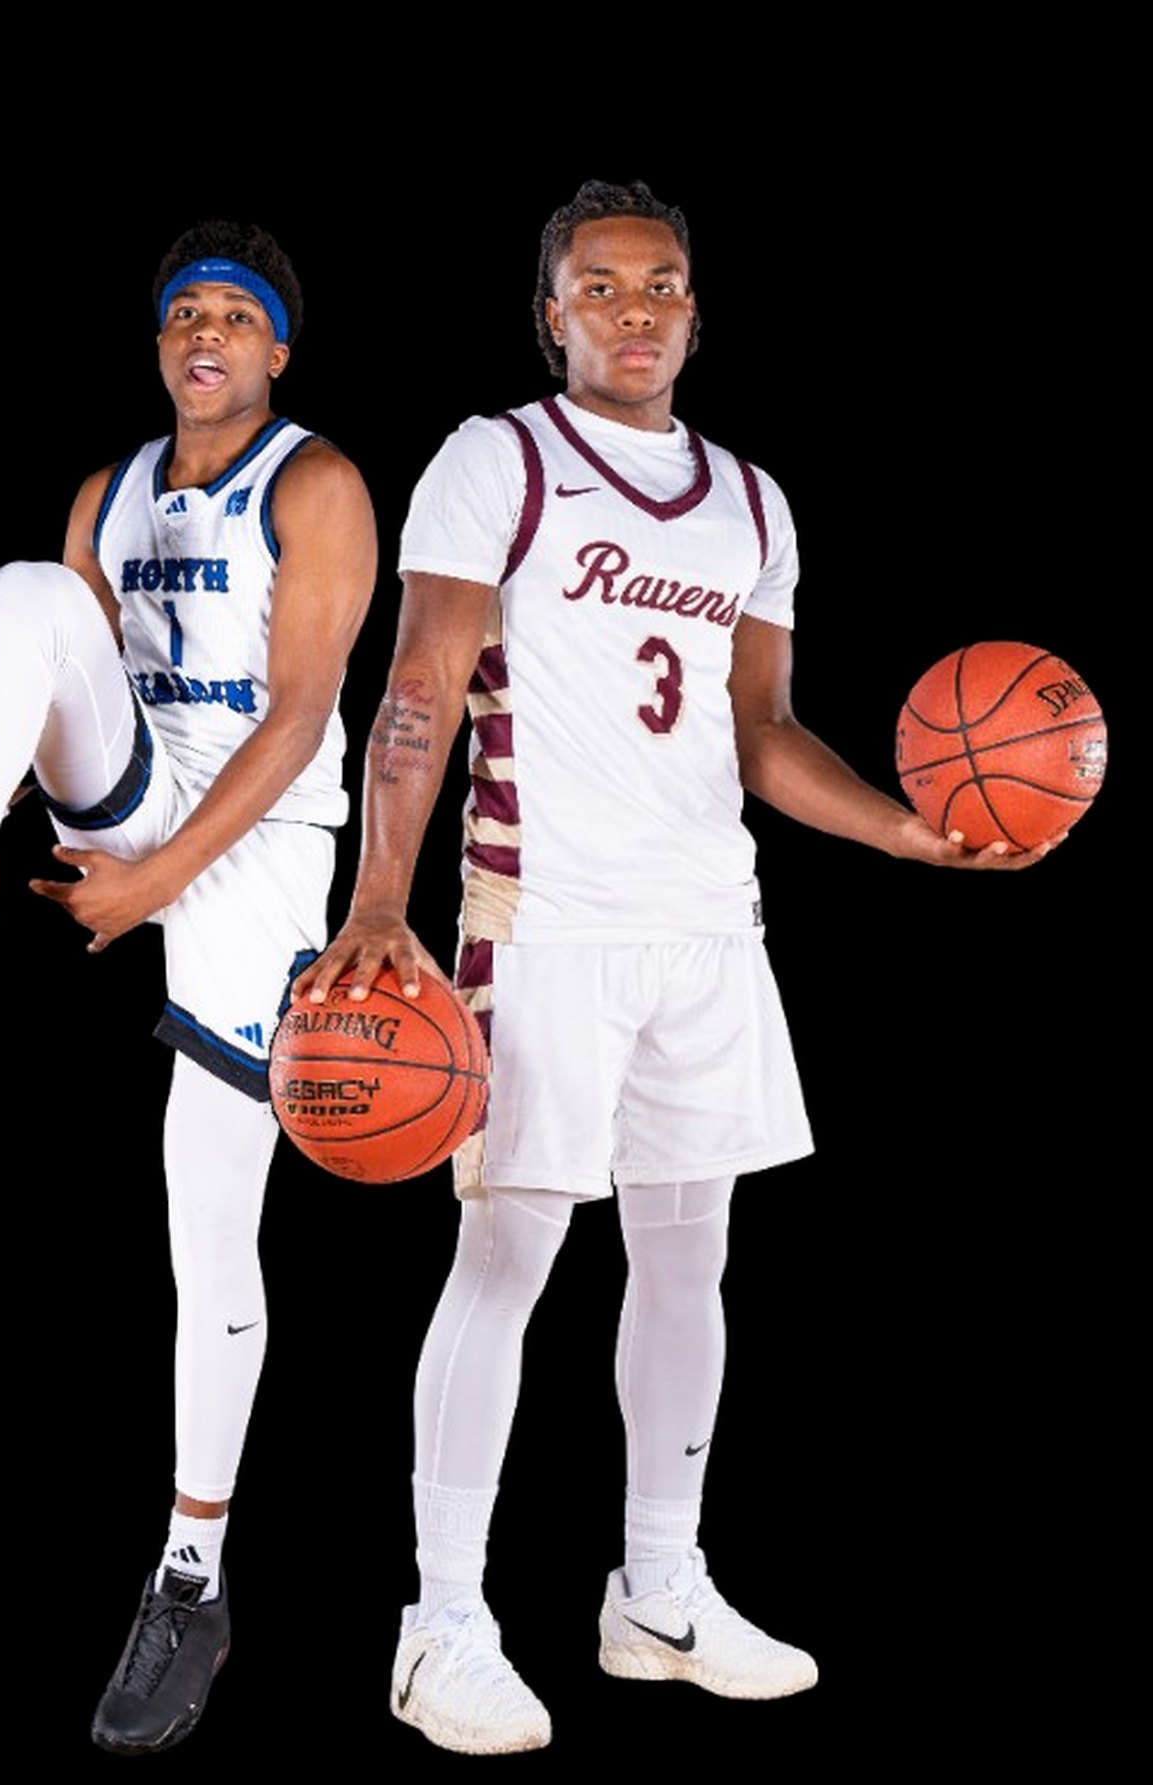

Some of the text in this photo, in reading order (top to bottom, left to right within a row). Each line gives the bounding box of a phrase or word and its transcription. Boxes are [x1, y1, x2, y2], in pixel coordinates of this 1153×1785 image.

[121, 558, 229, 593] NORTH
[562, 540, 740, 628] Ravens
[163, 600, 183, 667] 1
[635, 635, 684, 735] 3
[285, 1077, 382, 1101] EGACY
